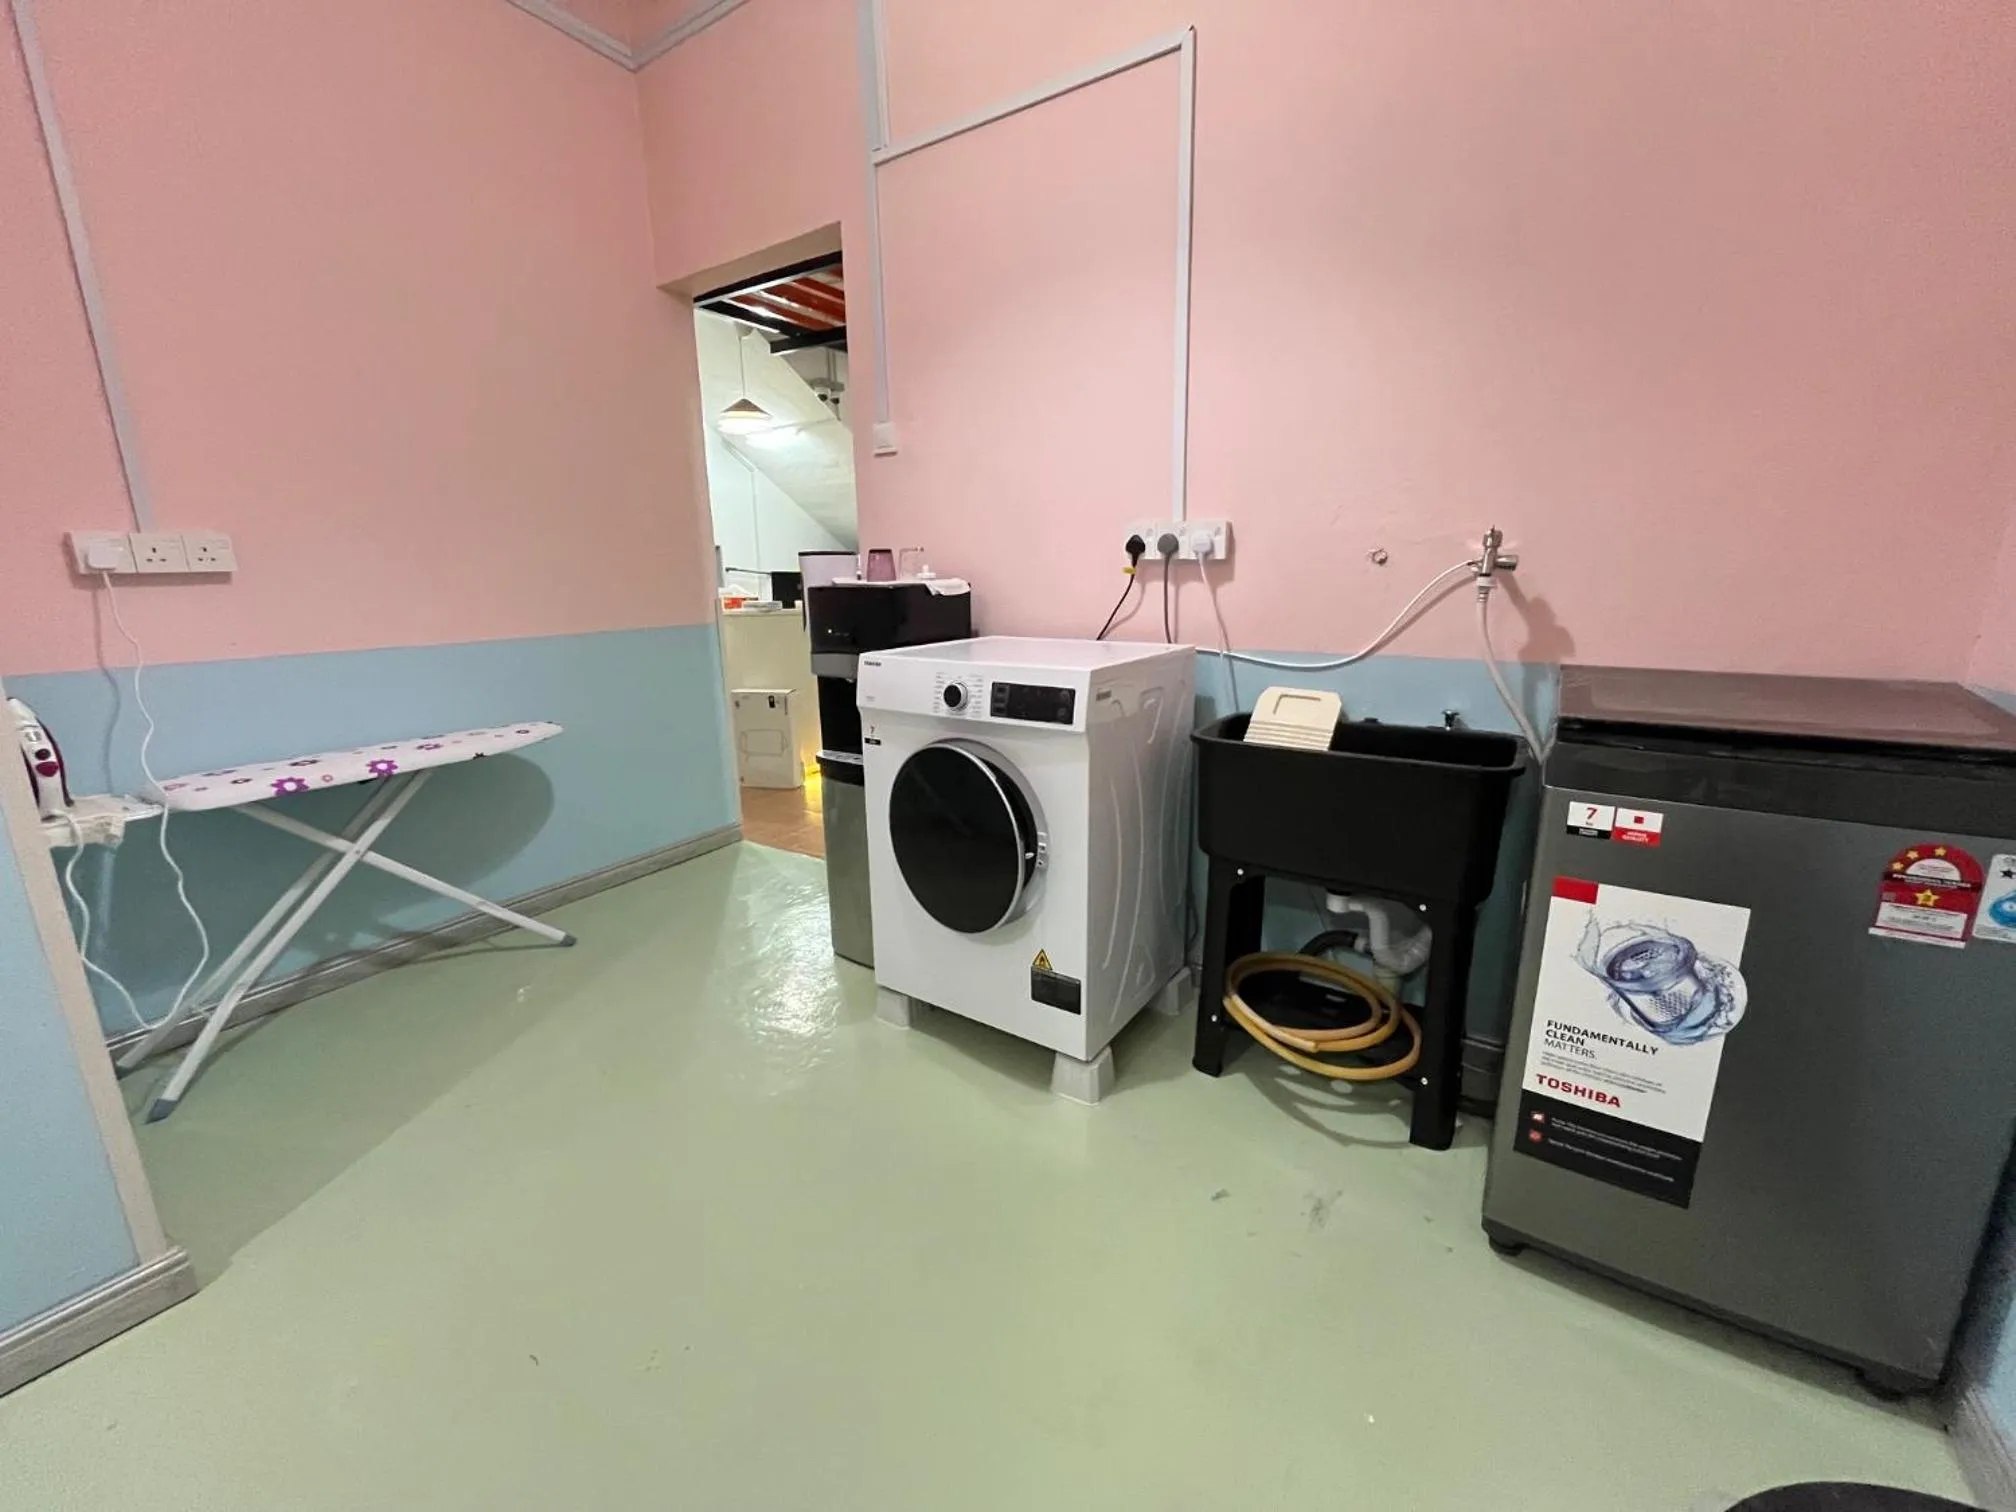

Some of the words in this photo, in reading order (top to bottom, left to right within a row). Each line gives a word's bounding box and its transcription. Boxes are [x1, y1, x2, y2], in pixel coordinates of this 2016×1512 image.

[1586, 807, 1598, 820] 7
[1545, 1029, 1585, 1046] CLEAN
[1547, 1019, 1659, 1055] FUNDAMENTALLY
[1536, 1073, 1621, 1108] TOSHIBA
